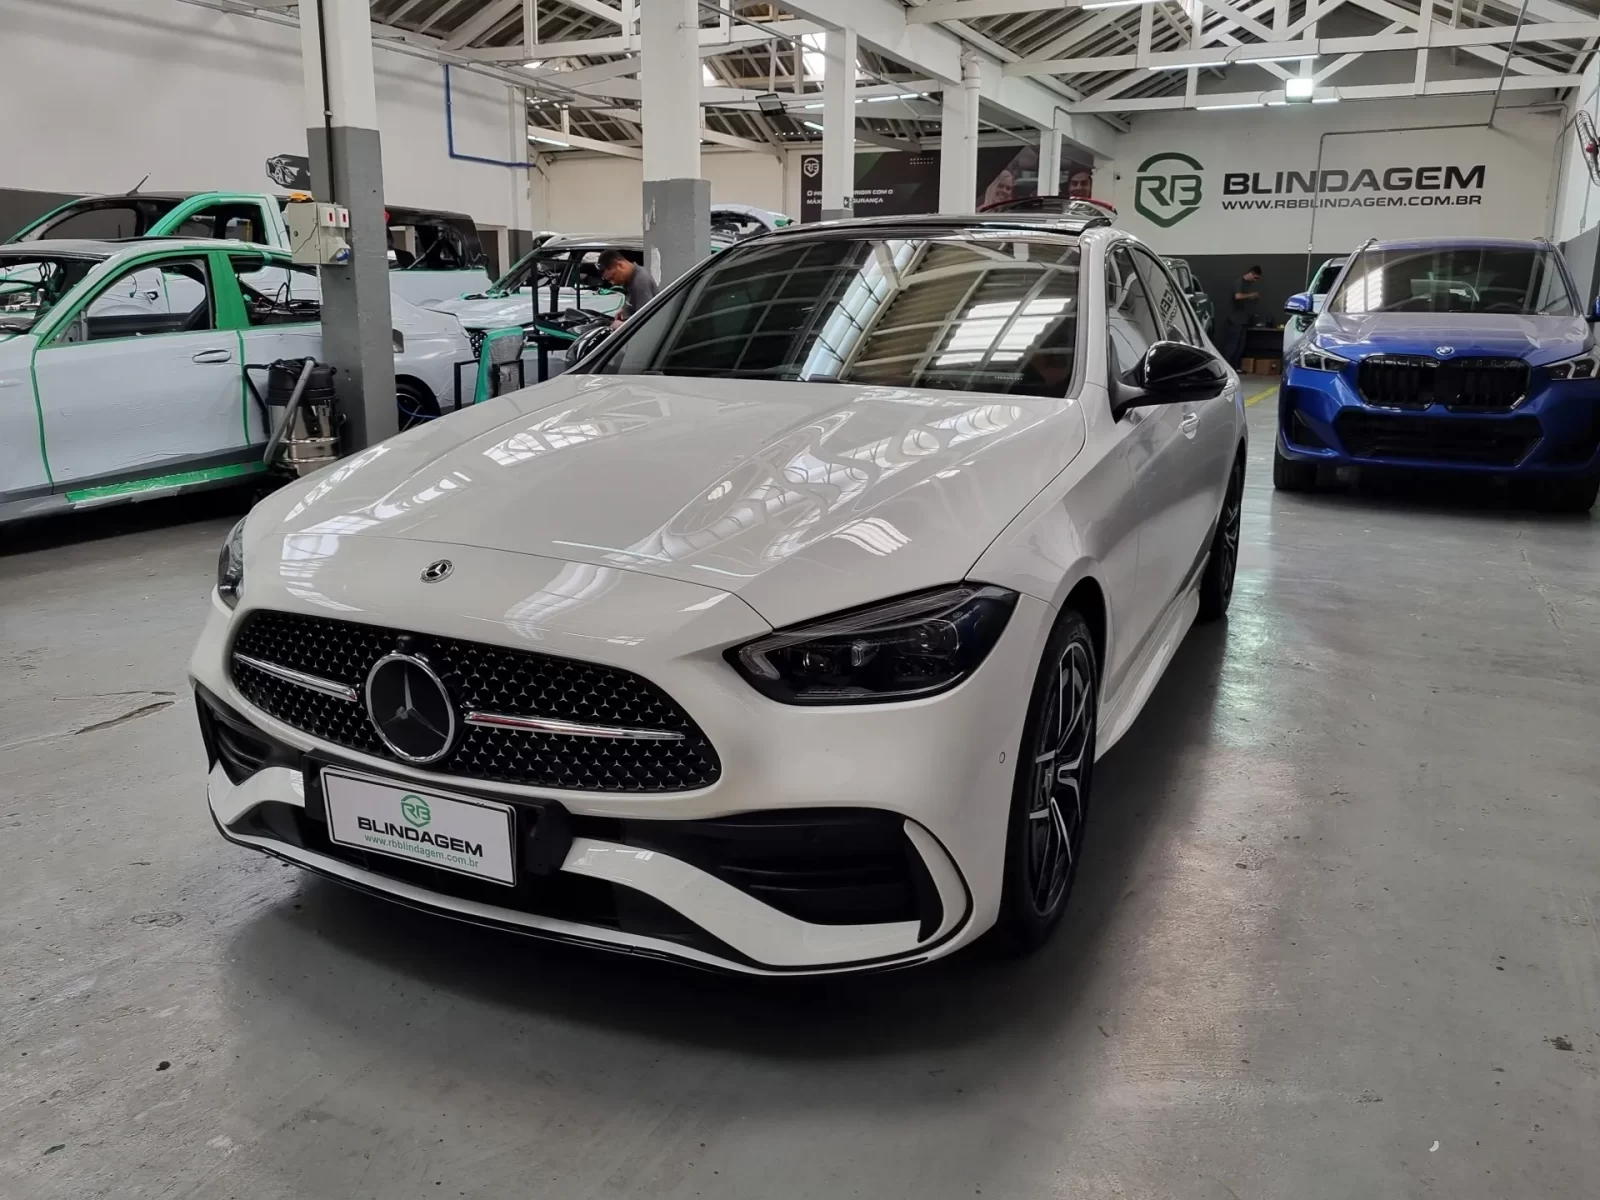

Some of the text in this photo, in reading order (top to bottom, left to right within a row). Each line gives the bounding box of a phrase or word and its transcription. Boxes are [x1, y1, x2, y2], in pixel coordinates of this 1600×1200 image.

[1223, 165, 1485, 195] BLINDAGEM
[1222, 195, 1482, 210] WWW.RBBLINDAGEM.COM.BR
[357, 816, 483, 857] BLINDAGEM
[364, 834, 479, 868] www.rbblindagem.com.br
